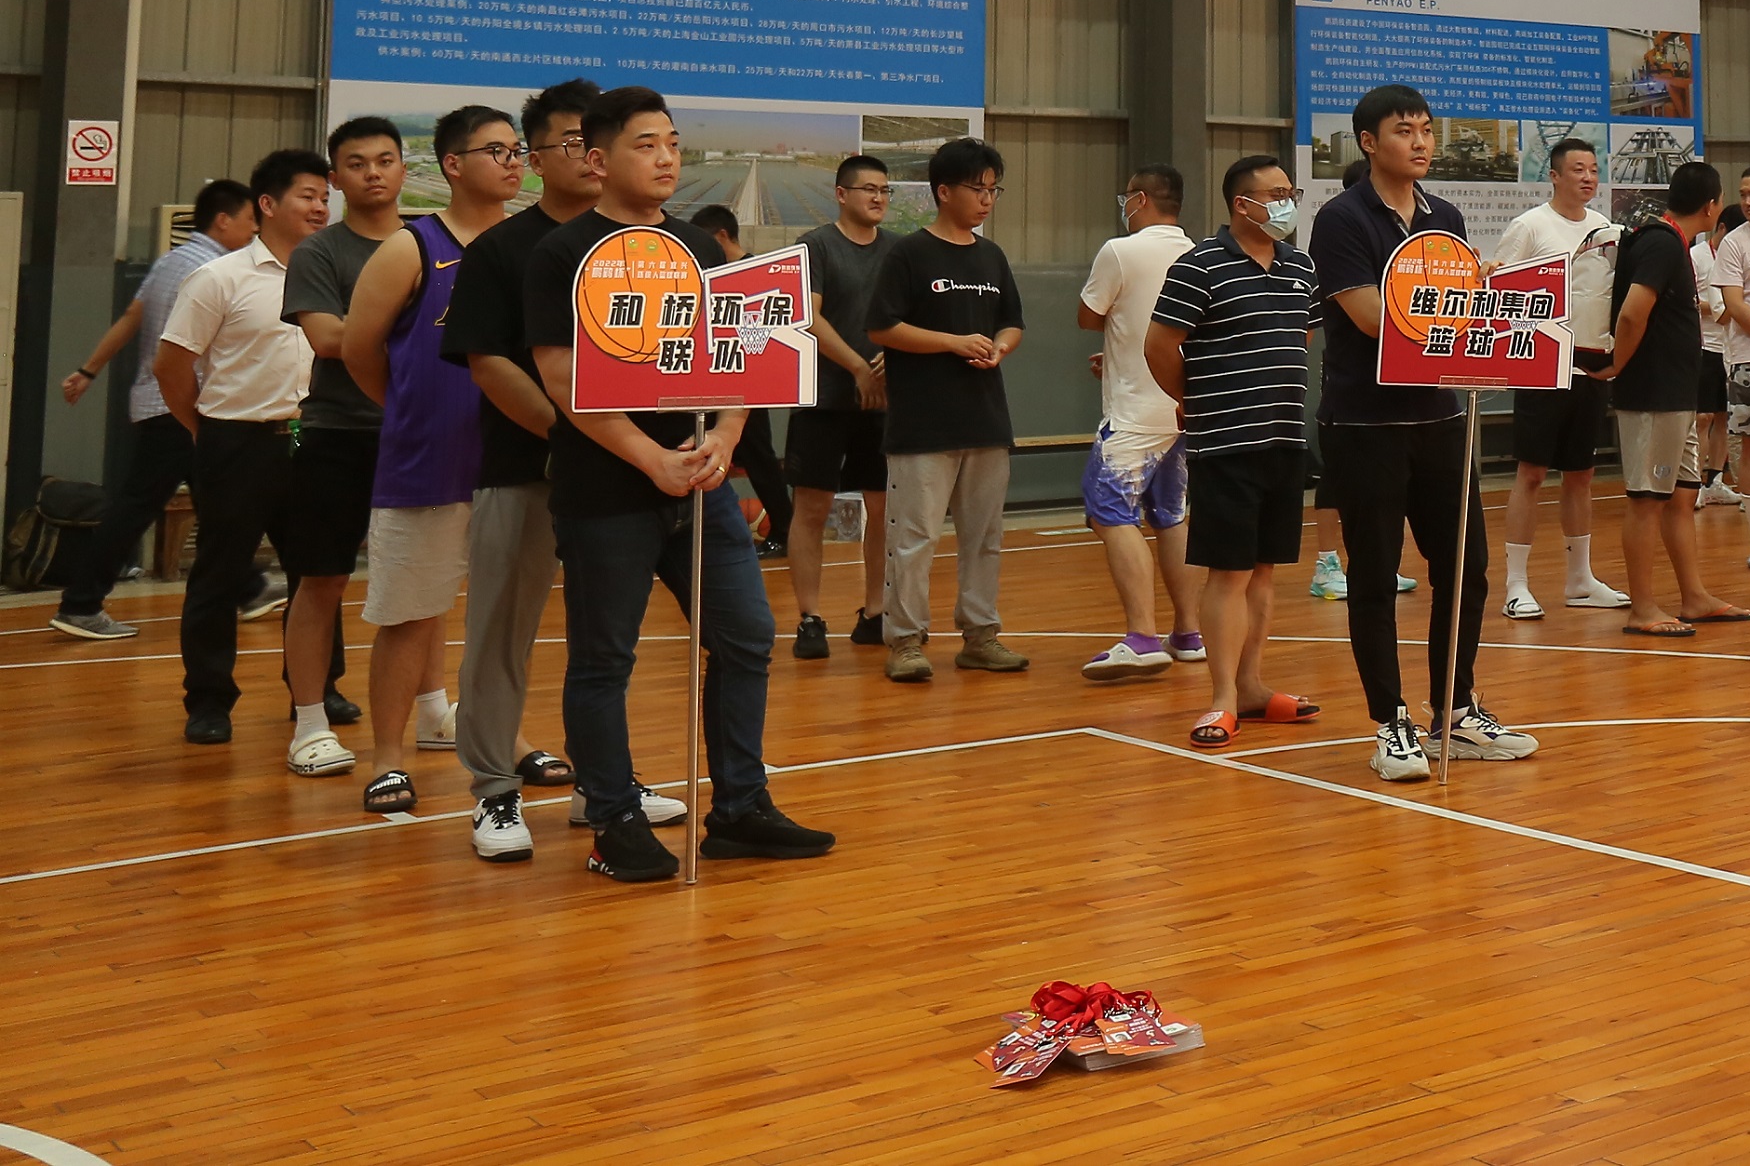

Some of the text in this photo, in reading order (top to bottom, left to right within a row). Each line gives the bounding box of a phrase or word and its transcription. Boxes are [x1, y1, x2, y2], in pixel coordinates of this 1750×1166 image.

[1419, 0, 1440, 11] E.P.
[71, 169, 111, 177] 禁止吸烟
[605, 292, 795, 327] 和桥环保
[1409, 285, 1555, 321] 维尔利集团
[657, 337, 745, 373] 联队
[1422, 325, 1536, 360] 篮球队
